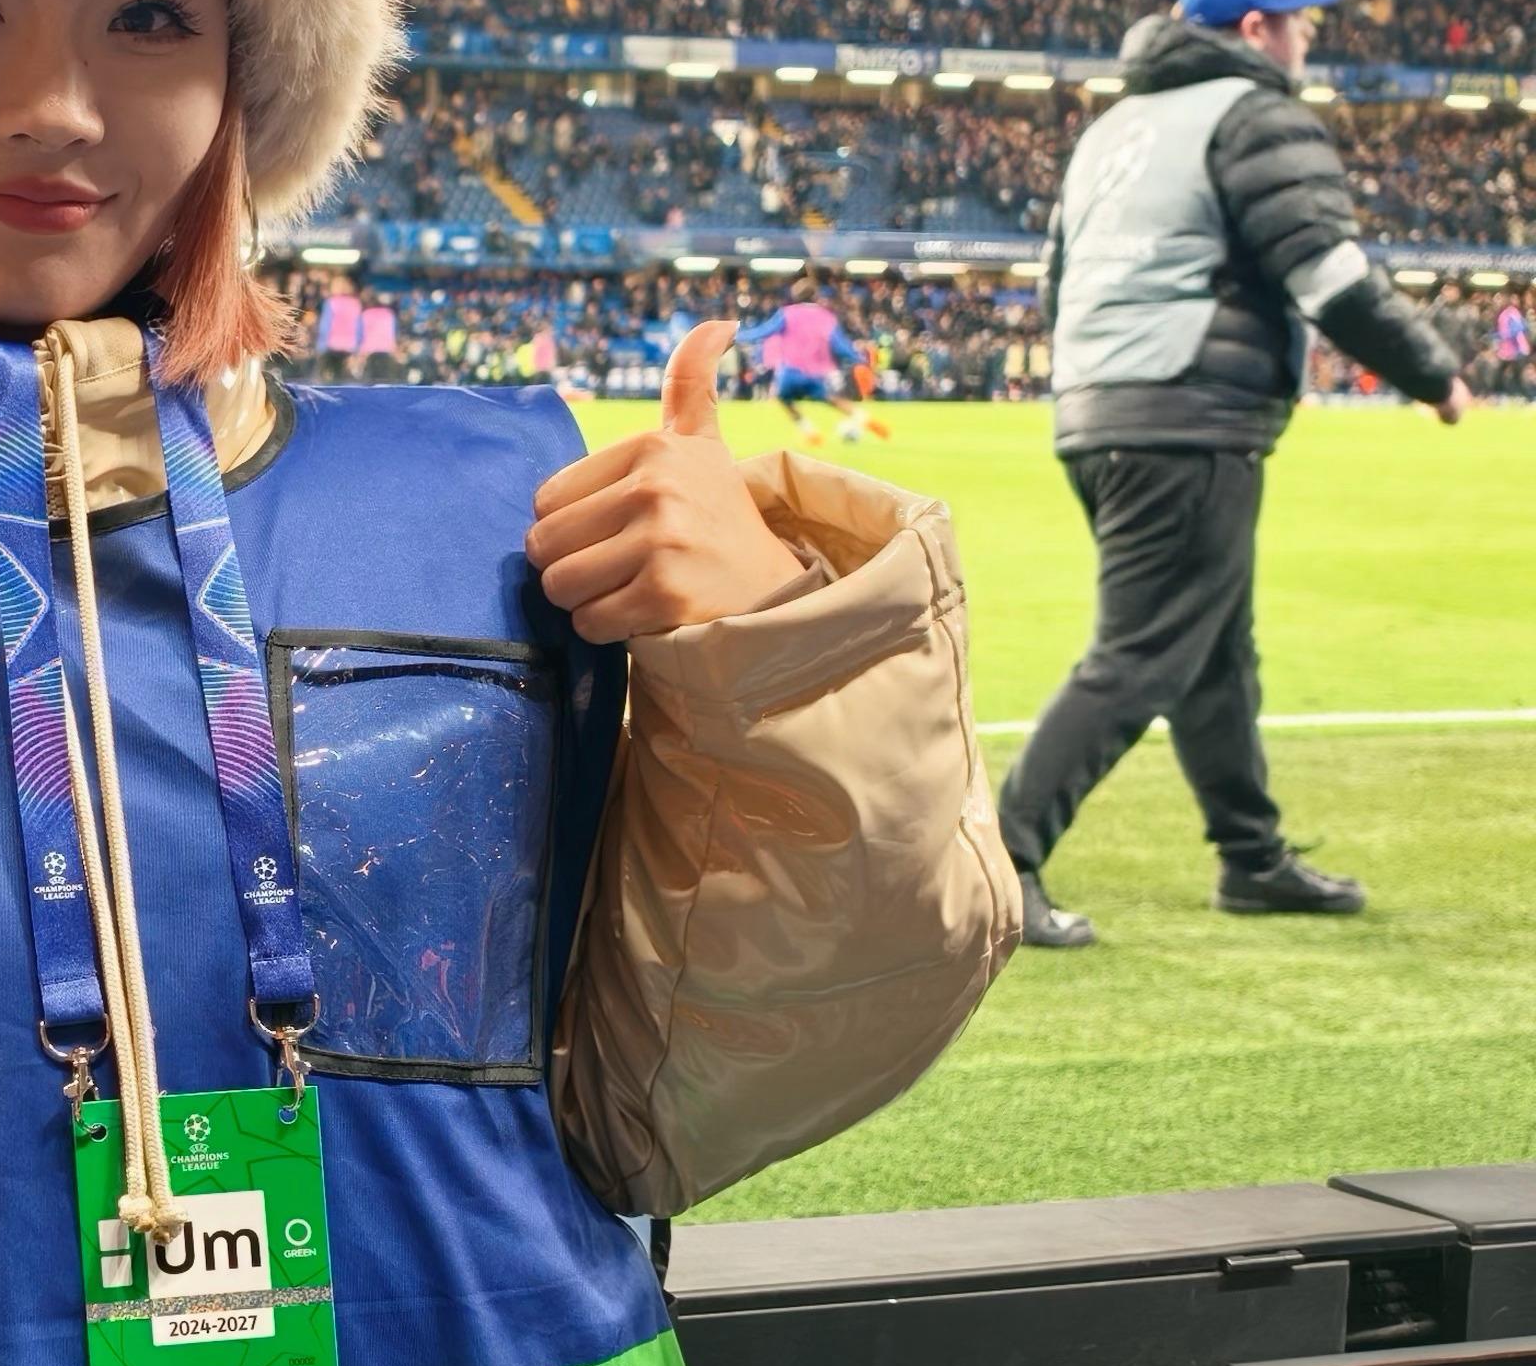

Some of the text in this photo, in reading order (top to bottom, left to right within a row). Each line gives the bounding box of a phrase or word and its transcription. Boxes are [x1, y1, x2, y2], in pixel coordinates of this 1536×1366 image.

[34, 884, 83, 893] CHAMPIONS
[244, 889, 294, 899] CHAMPIONS
[254, 897, 287, 905] LEAGUE
[171, 1152, 229, 1164] CHAMPIONS
[182, 1162, 220, 1172] LEAGUE
[284, 1248, 316, 1259] GREEN
[169, 1315, 258, 1337] 2024-2027
